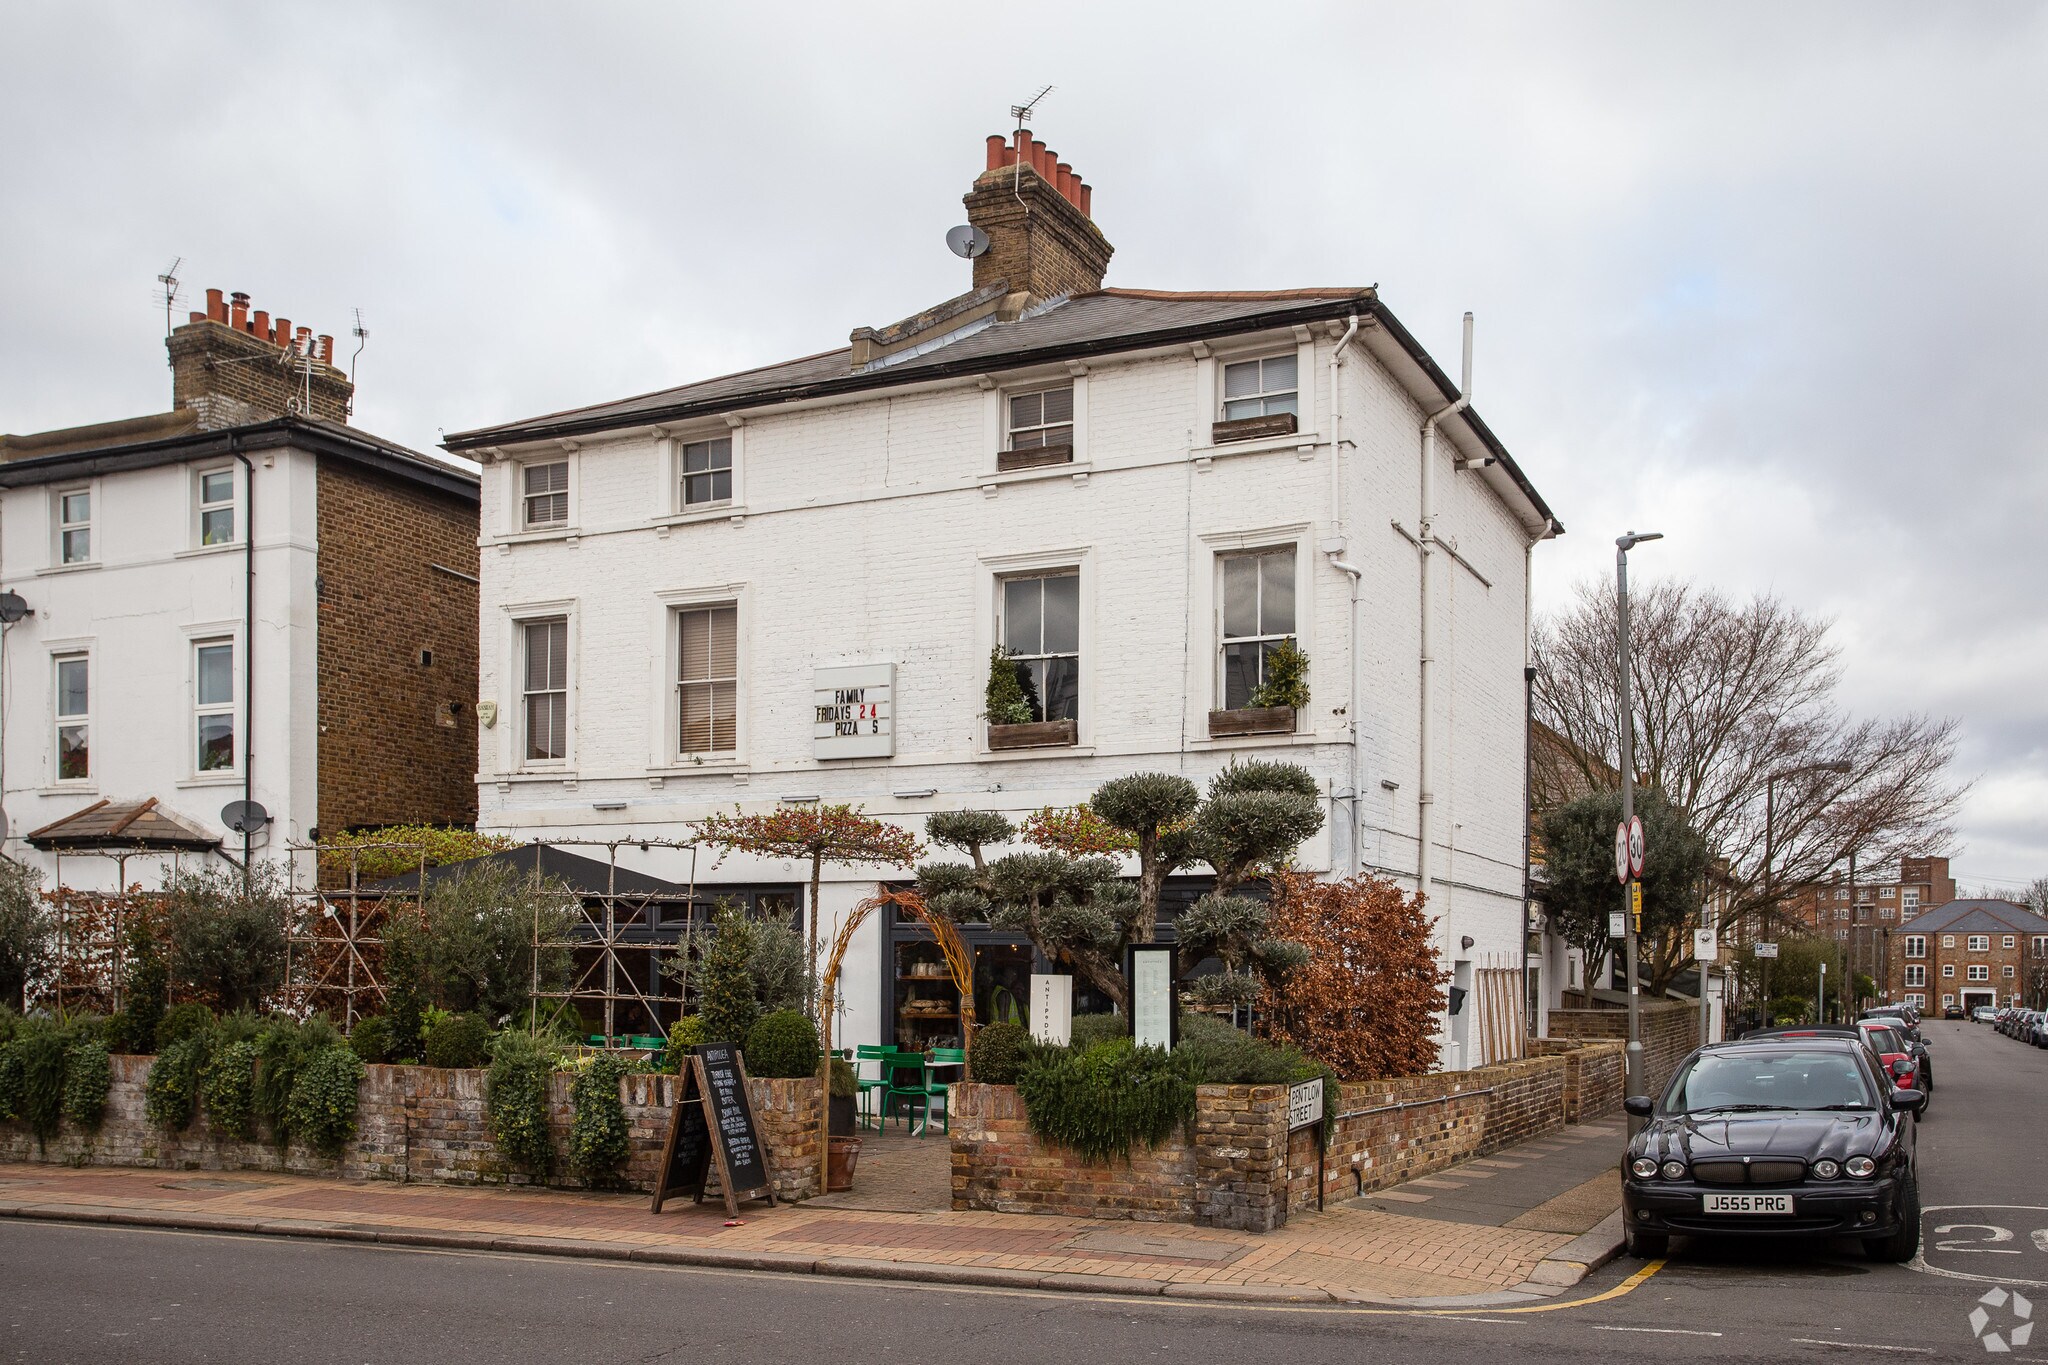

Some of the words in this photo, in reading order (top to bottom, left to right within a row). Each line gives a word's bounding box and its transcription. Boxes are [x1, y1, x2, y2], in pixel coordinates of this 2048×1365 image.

[835, 688, 865, 704] FAMILY
[816, 706, 851, 722] FRIDAYS
[860, 704, 866, 719] 2
[870, 704, 876, 718] 4
[835, 721, 858, 736] PIZZA
[872, 720, 878, 734] S
[1618, 840, 1627, 867] 20
[1631, 833, 1642, 860] 30
[1291, 1083, 1321, 1106] PENTLOW
[1289, 1104, 1312, 1125] STREET
[1710, 1197, 1740, 1211] J555
[1754, 1197, 1786, 1211] PRG
[1934, 1224, 2048, 1254] 2
